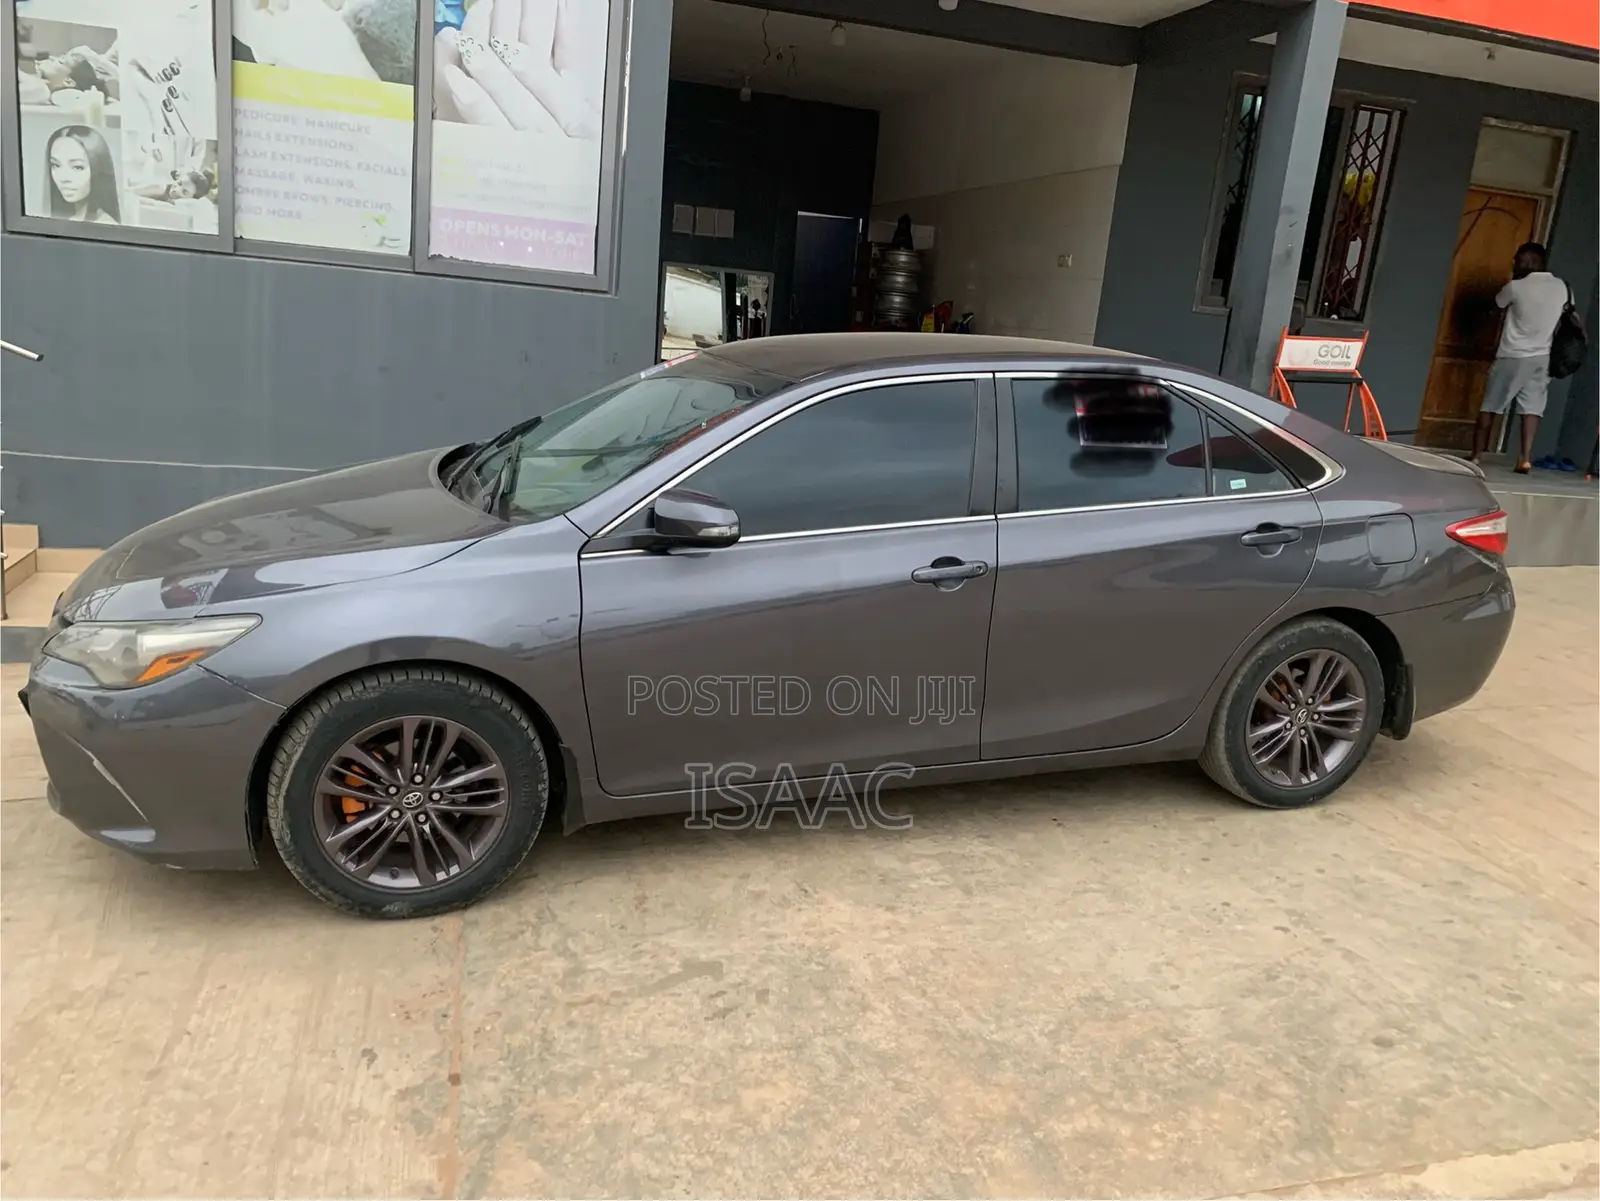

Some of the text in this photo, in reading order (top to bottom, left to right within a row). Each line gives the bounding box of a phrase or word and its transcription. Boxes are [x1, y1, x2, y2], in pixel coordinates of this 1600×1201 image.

[440, 218, 589, 247] OPENS MON-SAT
[1318, 344, 1351, 359] GOIL
